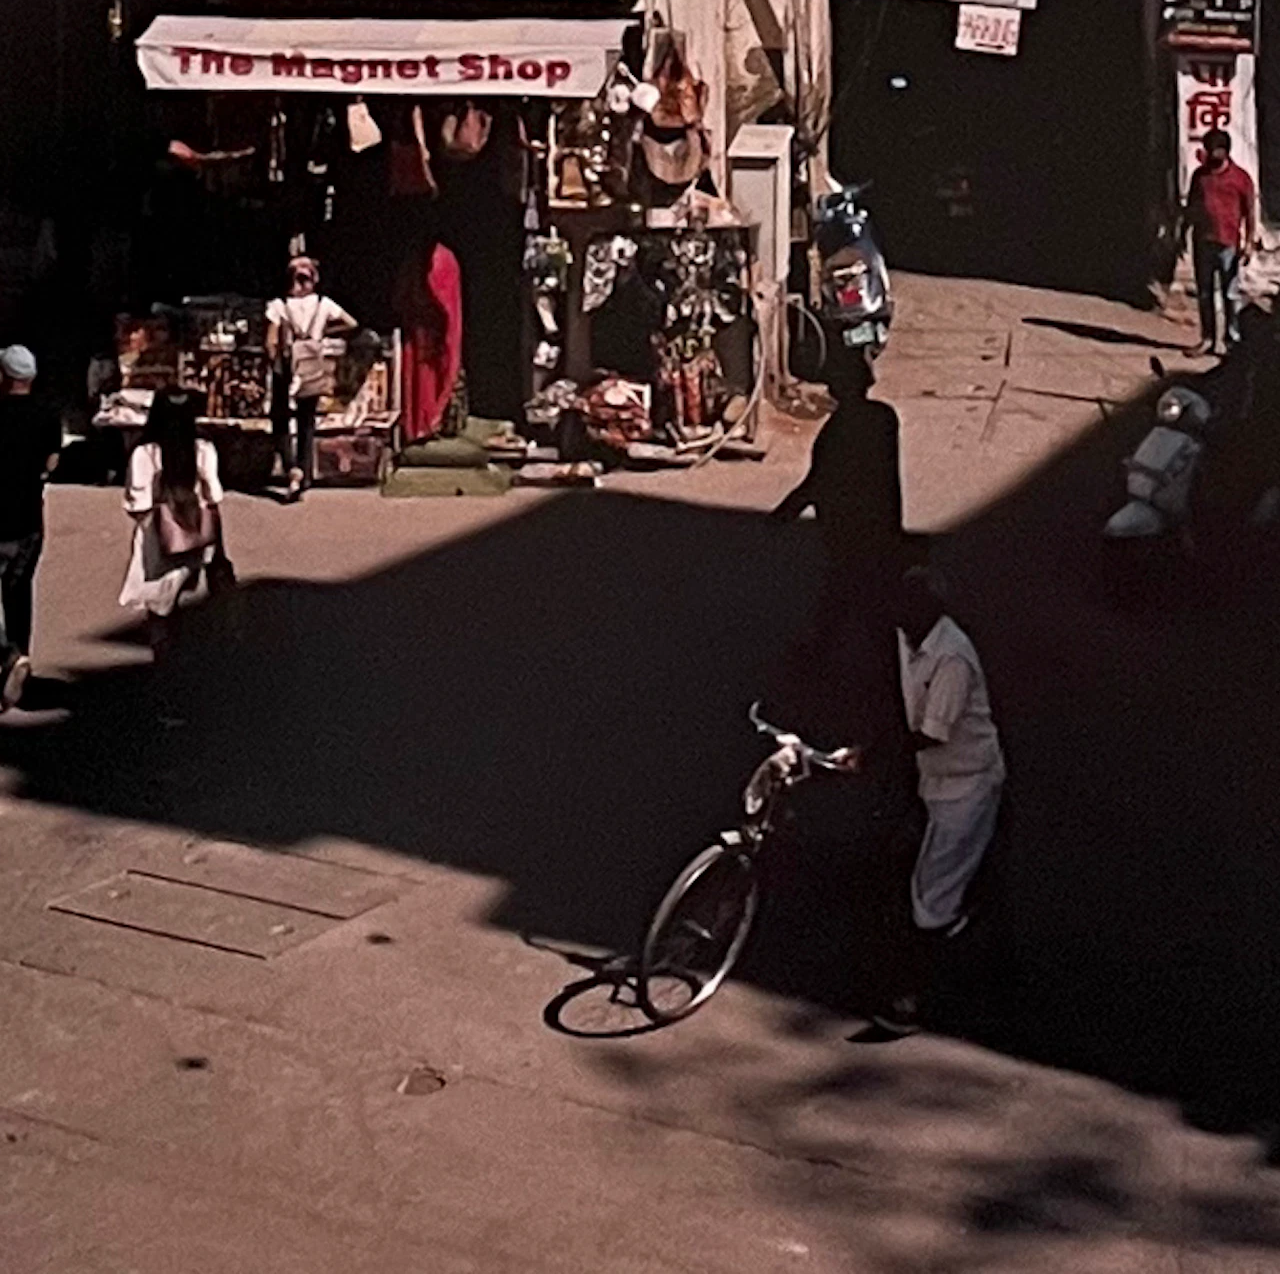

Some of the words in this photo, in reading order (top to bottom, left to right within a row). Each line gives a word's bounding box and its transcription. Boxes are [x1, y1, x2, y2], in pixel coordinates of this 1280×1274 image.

[172, 47, 255, 76] The
[271, 52, 441, 84] Magnet
[457, 53, 572, 88] Shop
